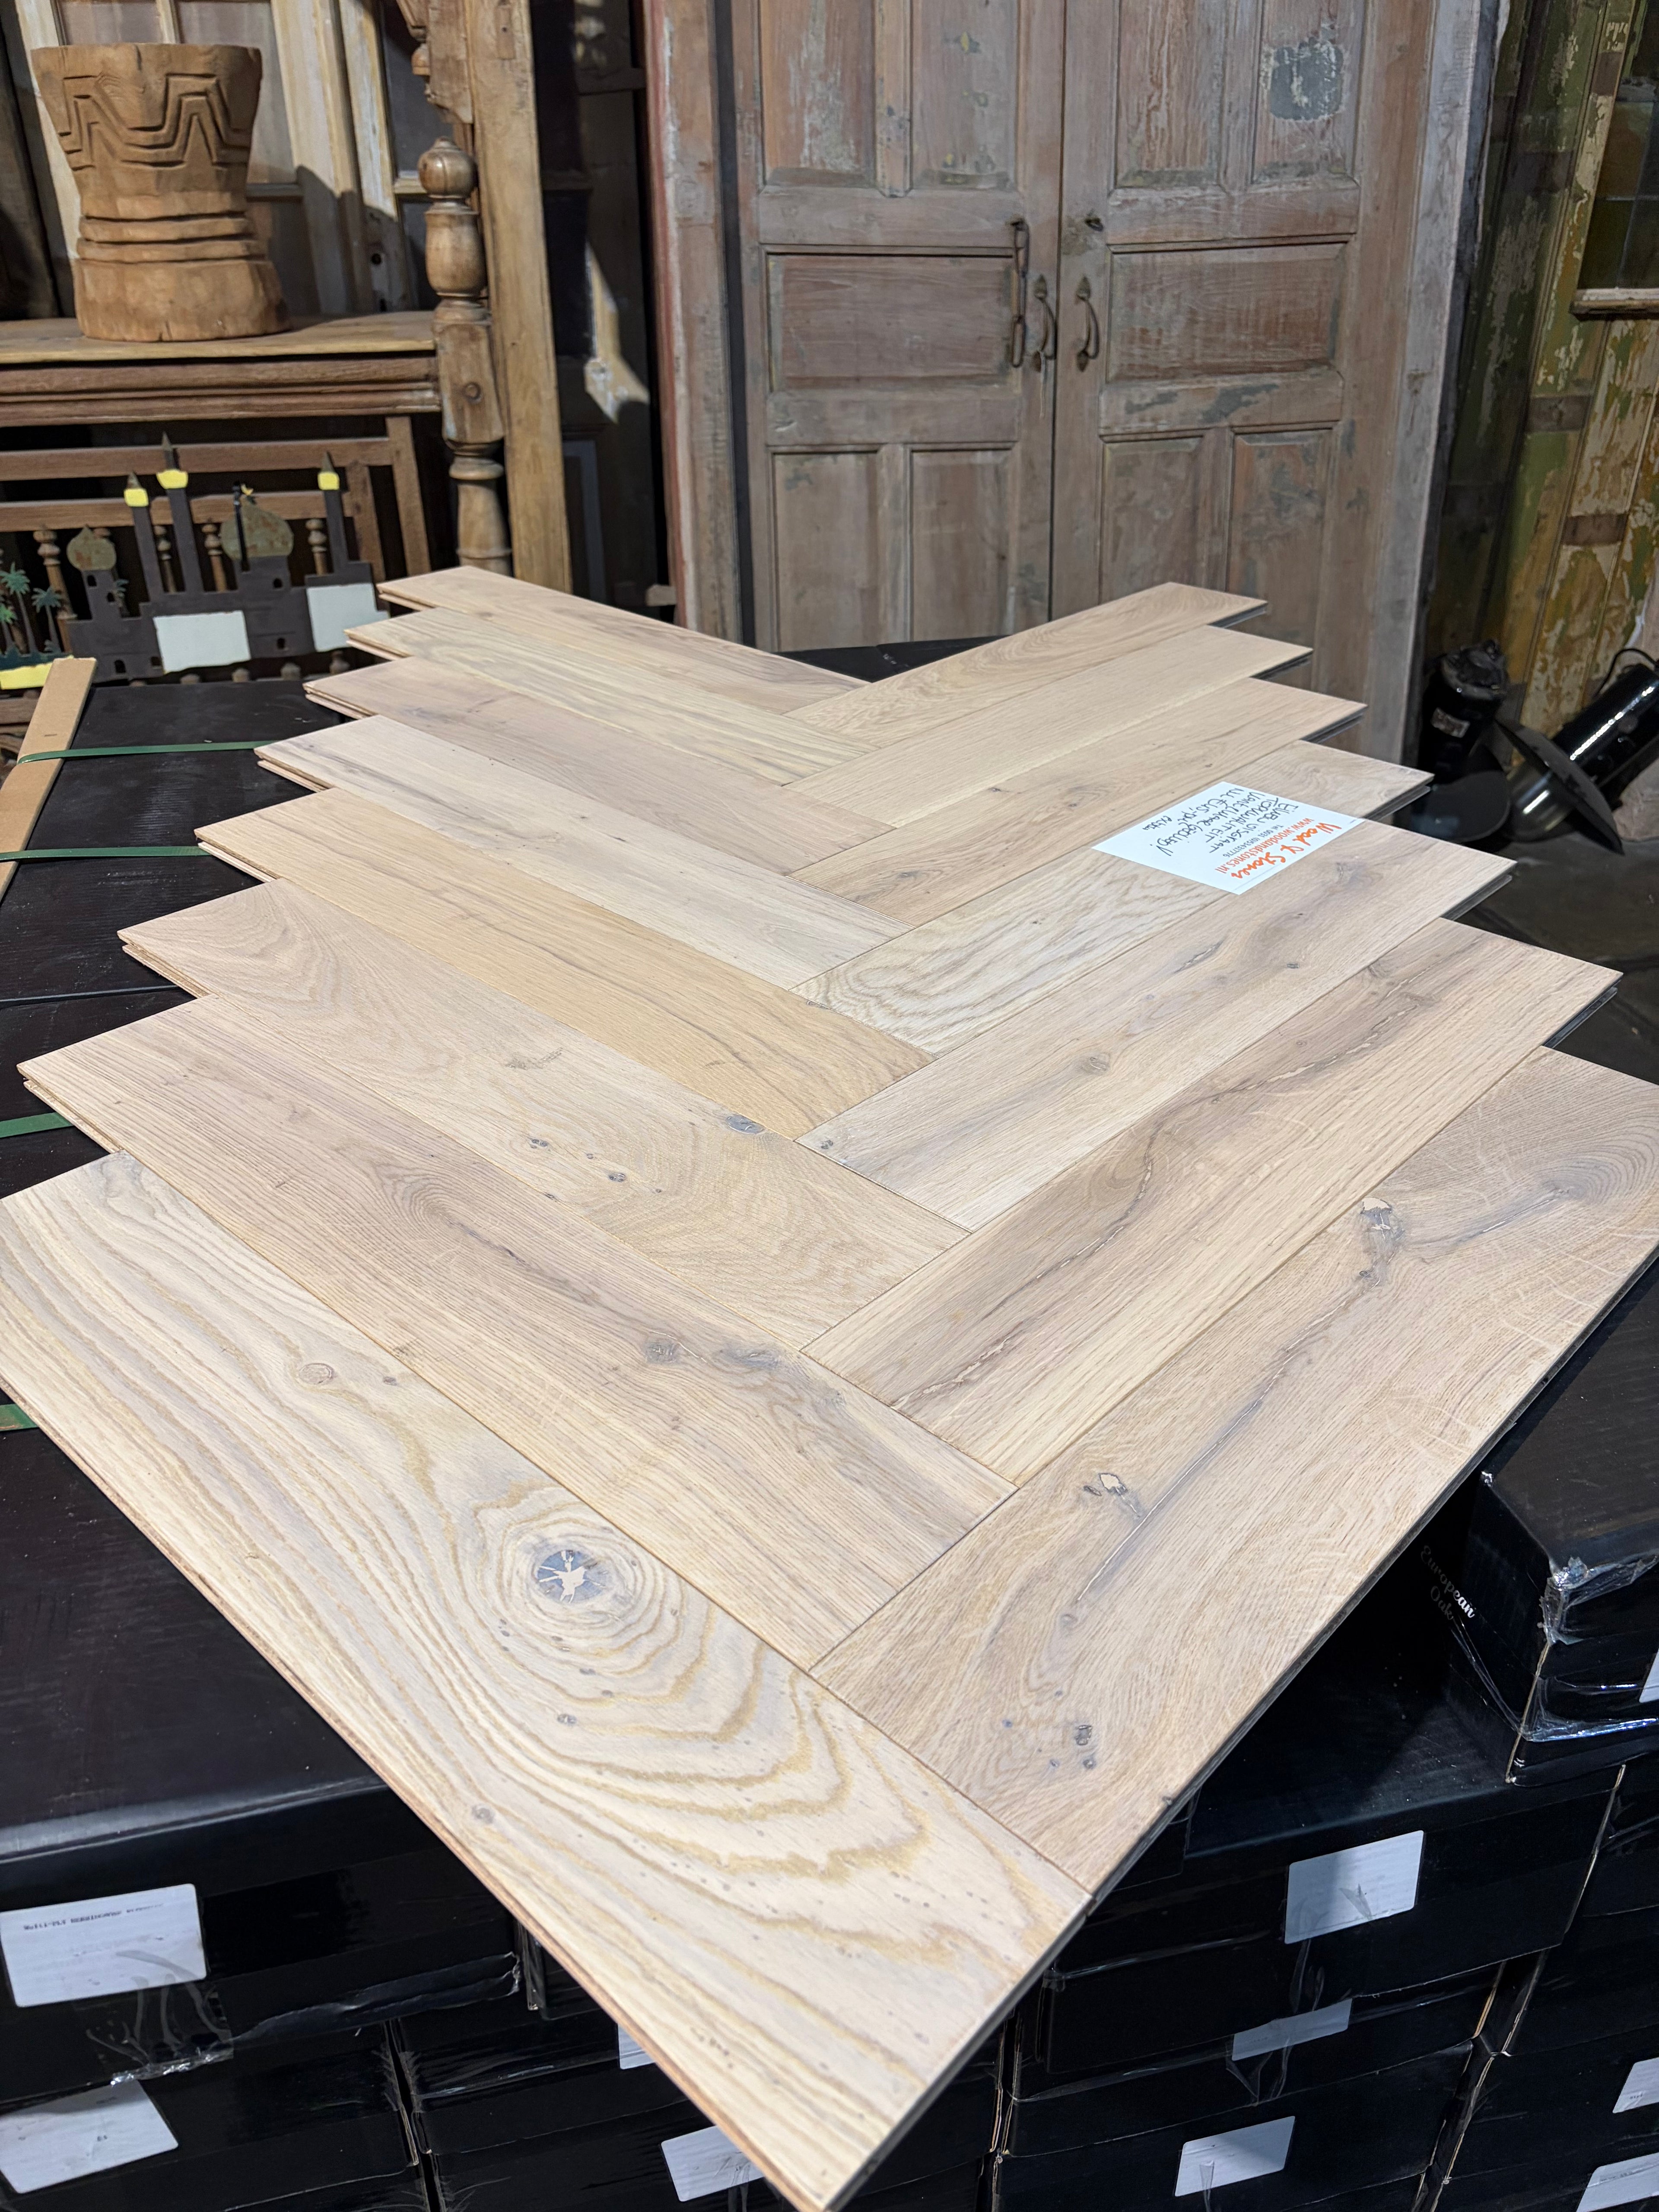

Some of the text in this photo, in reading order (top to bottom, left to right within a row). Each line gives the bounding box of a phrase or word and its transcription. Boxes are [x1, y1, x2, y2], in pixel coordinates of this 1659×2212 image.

[1214, 817, 1314, 874] www.woodandstones.nl
[1230, 822, 1342, 879] Wood & Stones
[1421, 1545, 1475, 1618] European
[1430, 1585, 1454, 1620] Oak
